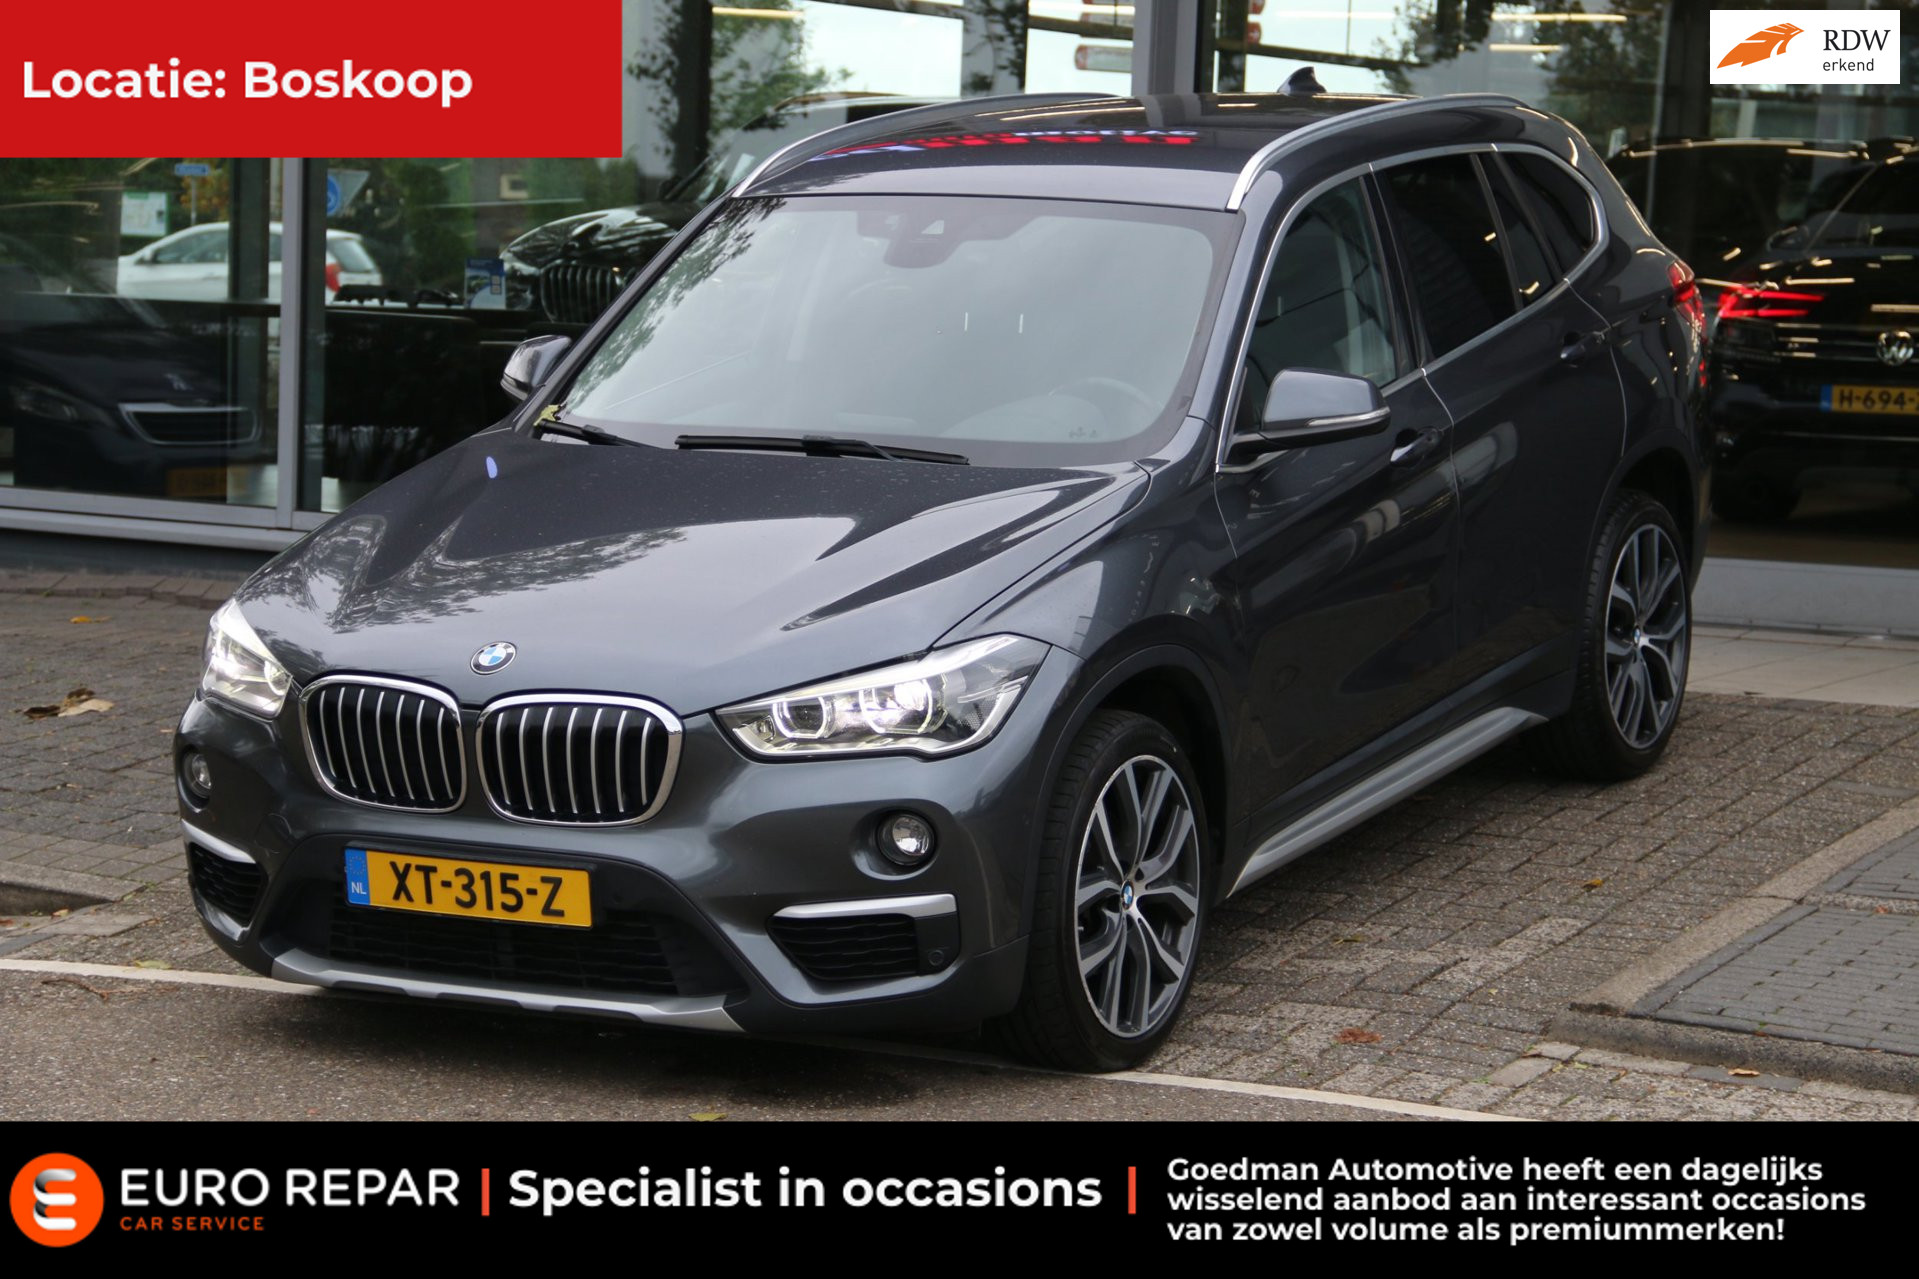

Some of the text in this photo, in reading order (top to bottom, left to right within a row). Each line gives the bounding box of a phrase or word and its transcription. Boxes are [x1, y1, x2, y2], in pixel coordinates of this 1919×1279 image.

[1839, 388, 1919, 411] H-694-
[351, 881, 367, 895] NL
[389, 860, 565, 918] XT-315-Z
